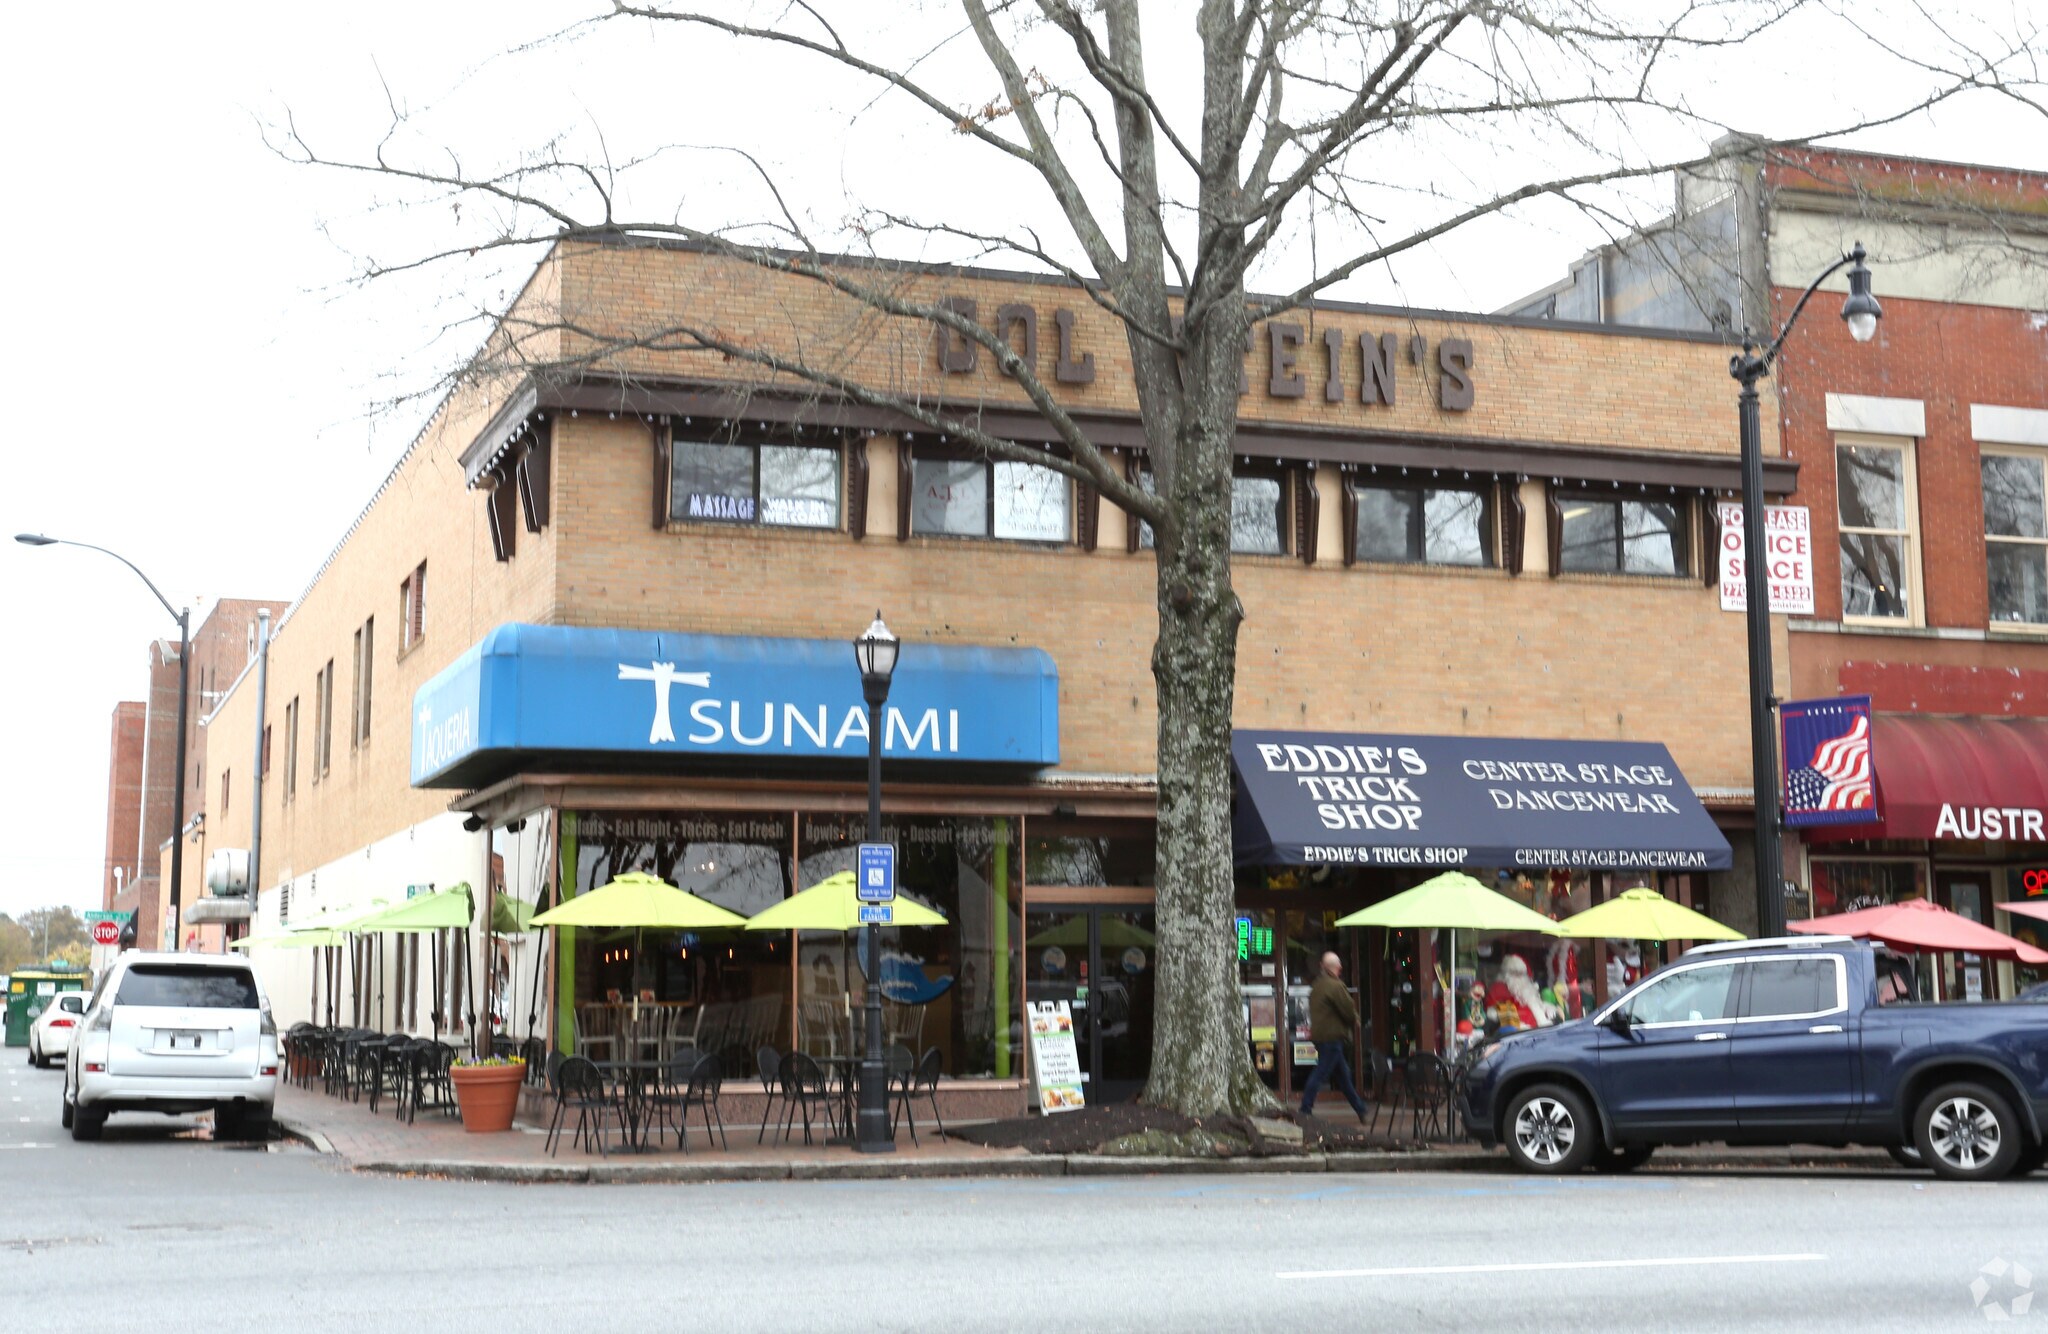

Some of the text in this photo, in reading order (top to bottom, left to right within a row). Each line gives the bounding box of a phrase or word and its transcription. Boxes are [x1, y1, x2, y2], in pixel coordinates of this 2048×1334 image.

[937, 297, 1476, 412] GOLEIN'S
[690, 493, 754, 520] MASSAGE
[762, 509, 829, 523] WELCOME
[1721, 508, 1806, 530] FO EASE
[1723, 533, 1806, 555] OICE
[1728, 558, 1804, 580] SCE
[618, 661, 958, 752] TSUNAMI
[418, 703, 470, 776] TAQUERIA
[1256, 743, 1427, 775] EDDIE'S
[1463, 759, 1673, 786] CENTER STAGE
[1297, 776, 1421, 802] TRICK
[1488, 788, 1680, 814] DANCEWEAR
[615, 819, 634, 837] Eat
[636, 819, 672, 839] Right
[681, 820, 718, 838] Tacos
[728, 820, 749, 839] Eat
[750, 820, 784, 839] Fresh
[1317, 803, 1423, 831] SHOP
[1934, 803, 2046, 841] AUSTR
[805, 823, 839, 842] Bowls
[910, 824, 953, 842] Dessert
[1304, 846, 1467, 864] EDDIE'S TRICK SHOP
[1515, 849, 1707, 867] CENTER STAGE DANCEWEAR
[95, 926, 118, 939] STOP
